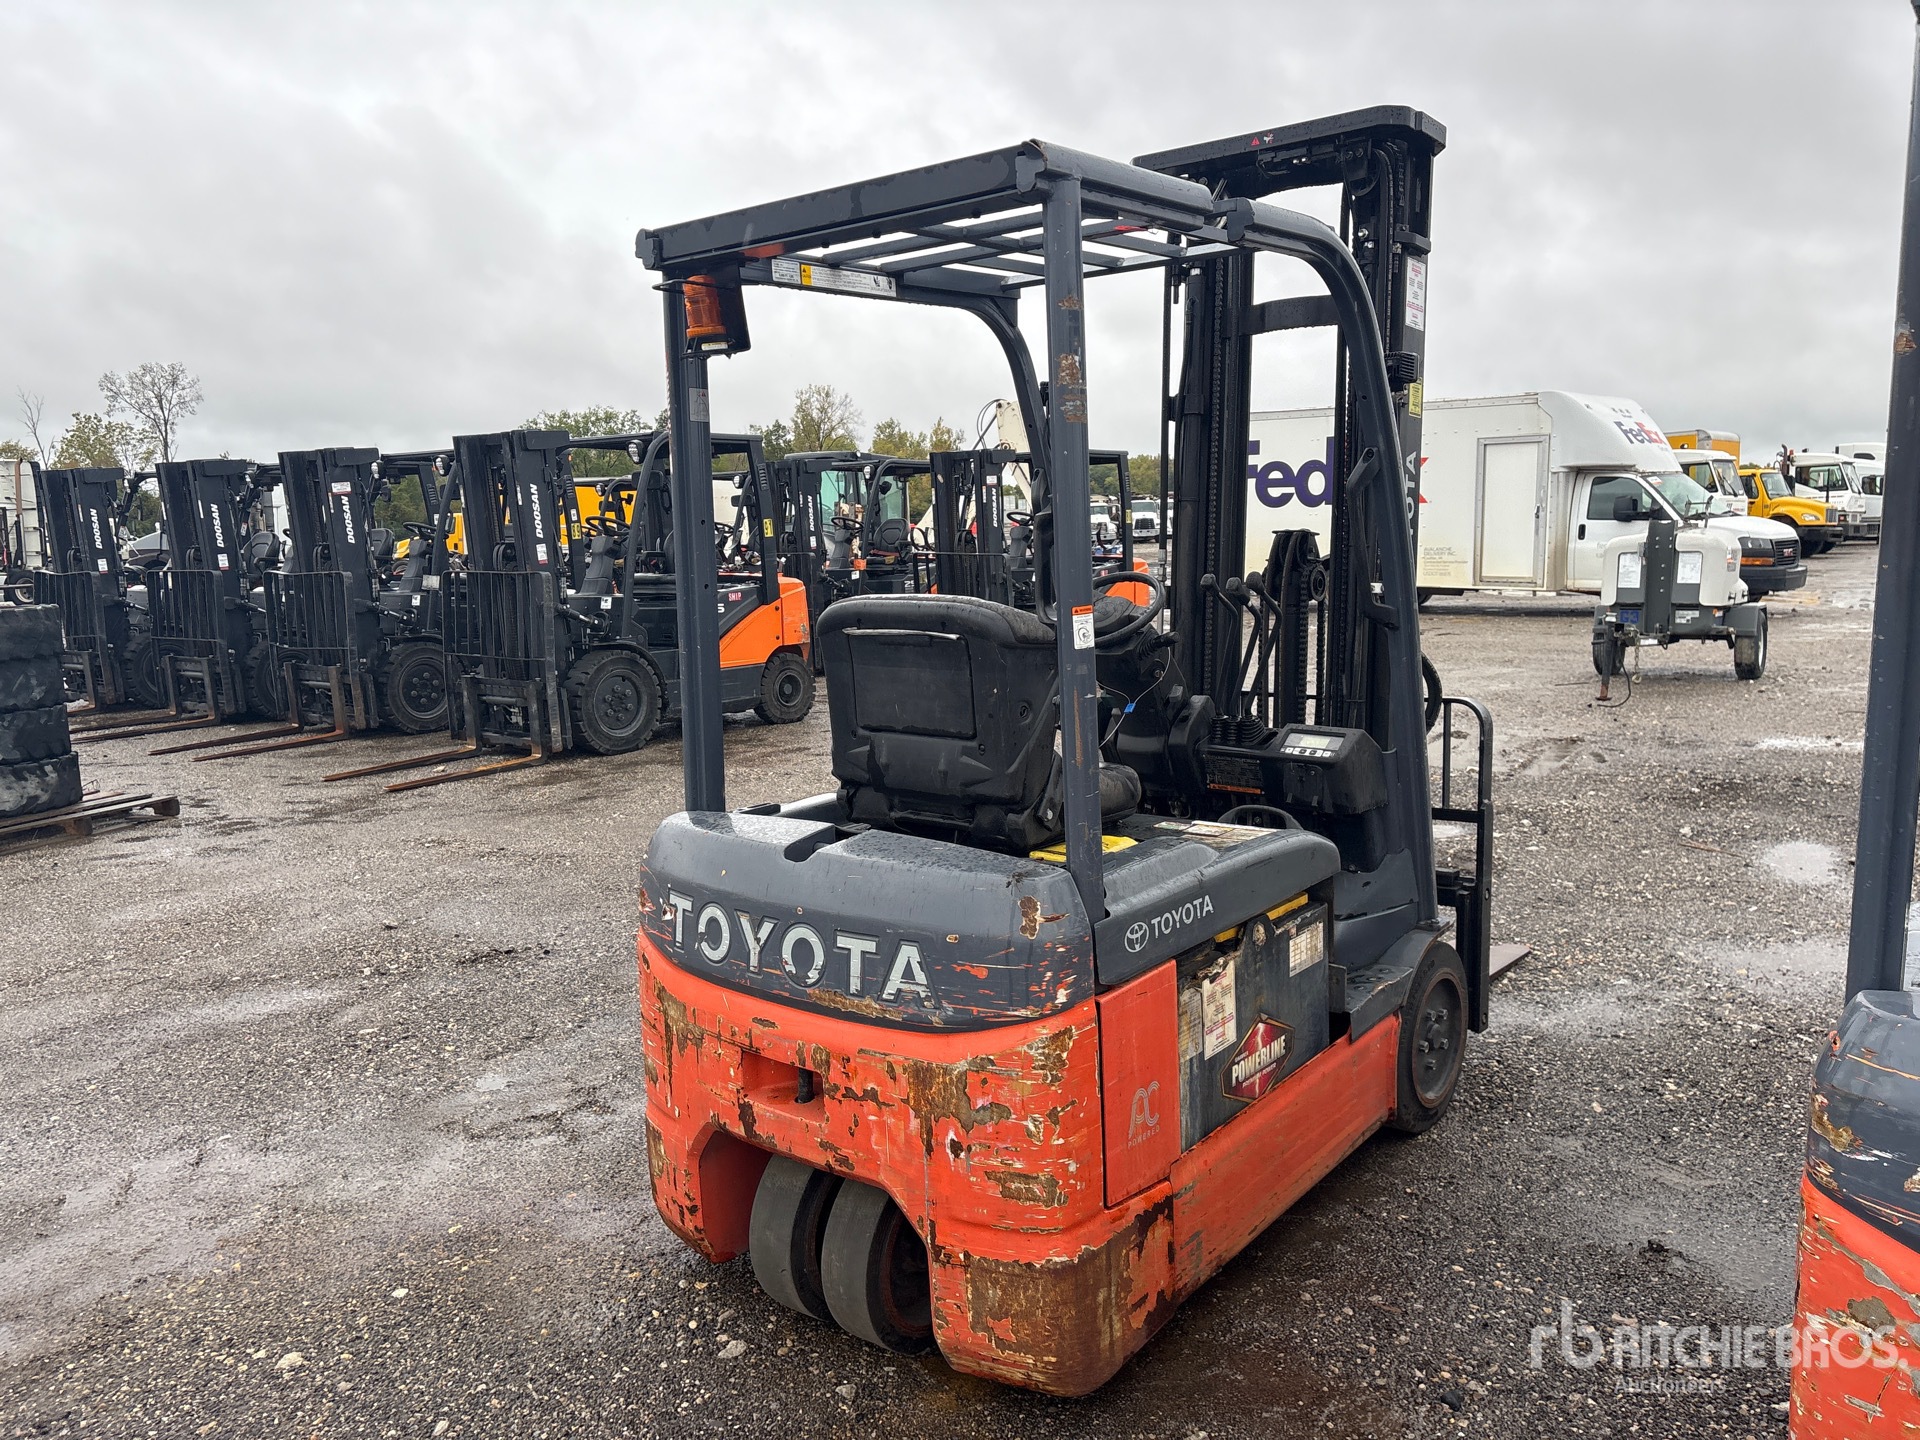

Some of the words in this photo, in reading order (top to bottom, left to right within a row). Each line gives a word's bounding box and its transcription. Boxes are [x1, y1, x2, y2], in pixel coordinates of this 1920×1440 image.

[1613, 421, 1667, 445] FedEx
[89, 508, 103, 549] DOOSAN
[210, 503, 224, 548] DOOSAN
[340, 495, 355, 544] DOOSAN
[530, 483, 543, 539] DOOSAN
[807, 494, 815, 532] DOOSAN
[1151, 895, 1214, 939] TOYOTA
[668, 889, 937, 1008] TOYOTA
[1232, 1034, 1287, 1087] POWERLINE
[1127, 1125, 1160, 1150] POWERED
